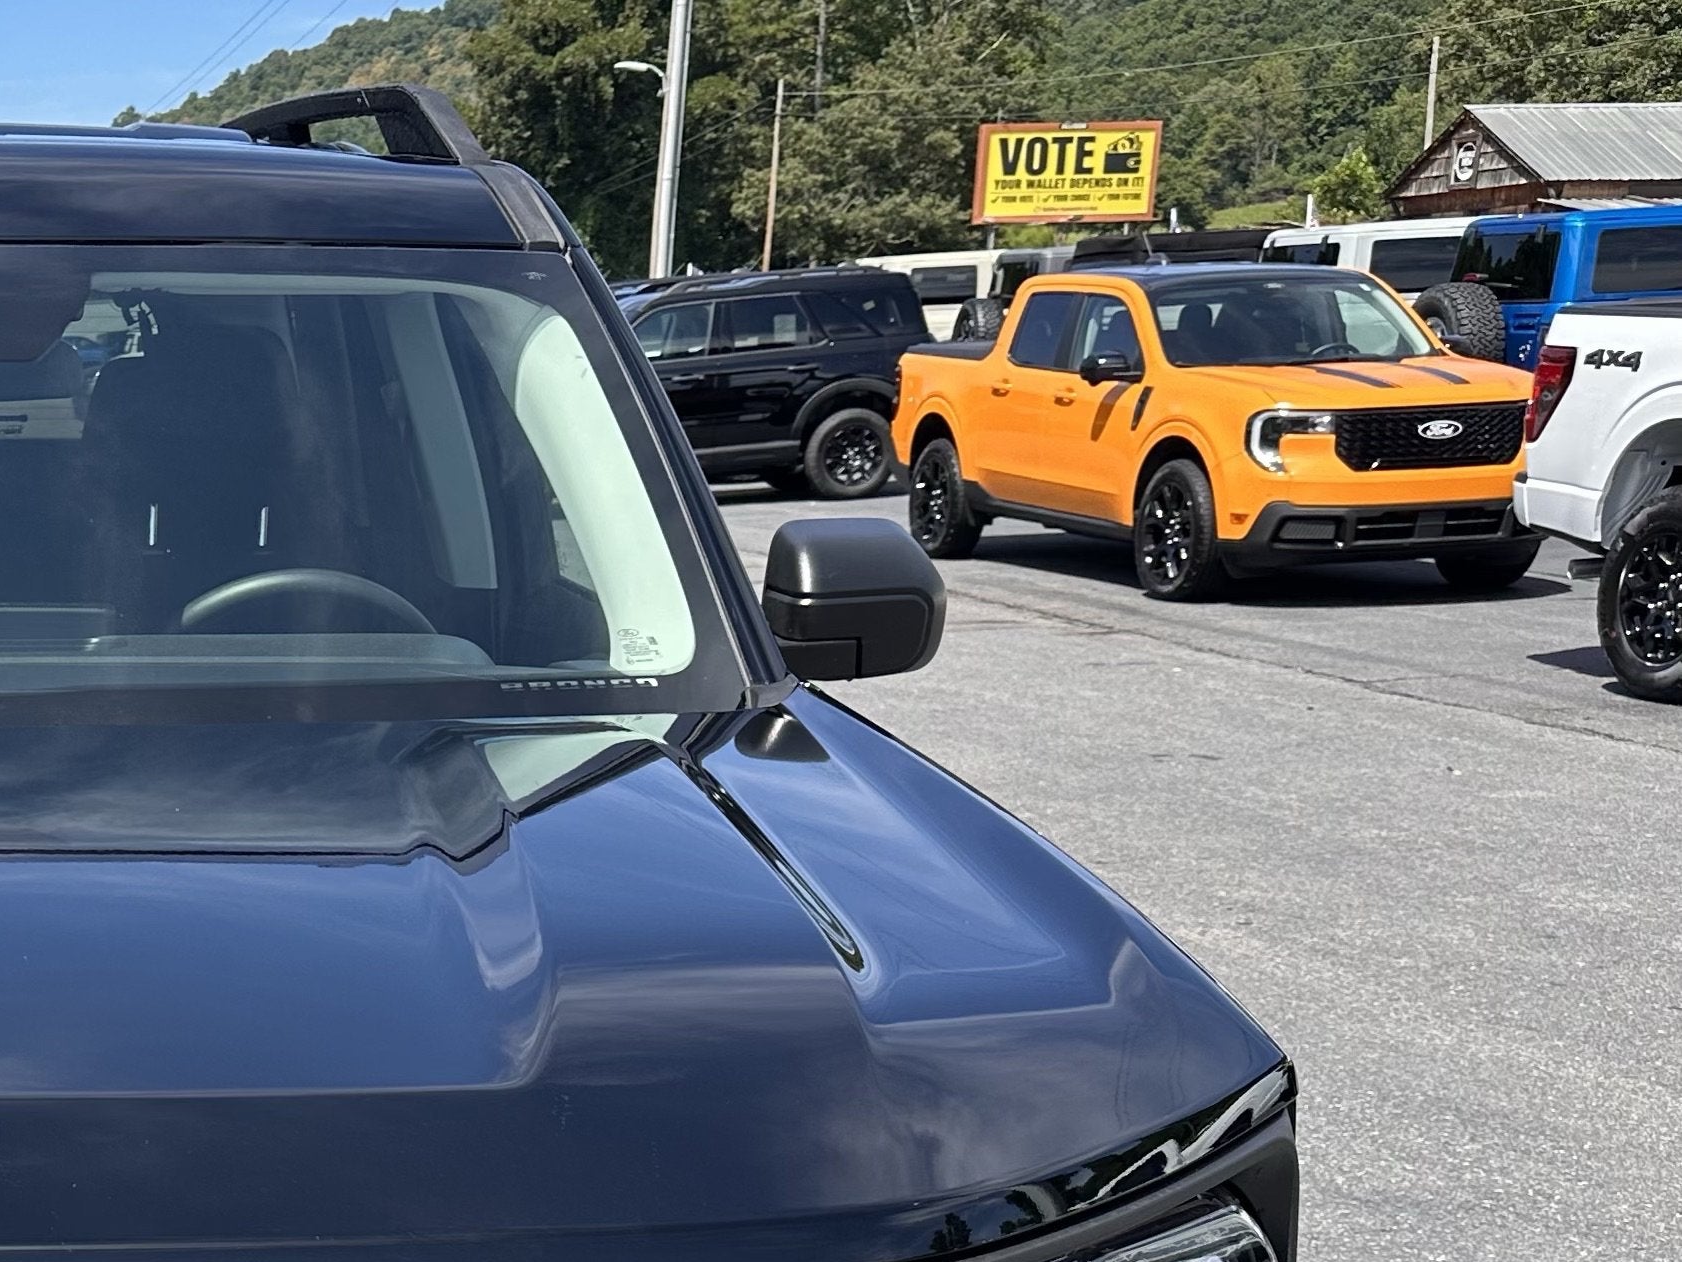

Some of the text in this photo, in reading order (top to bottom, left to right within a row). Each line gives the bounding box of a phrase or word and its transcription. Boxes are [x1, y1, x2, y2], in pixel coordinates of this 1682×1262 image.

[999, 136, 1096, 176] VOTE
[994, 178, 1022, 190] YOUR
[1025, 177, 1066, 189] WALLET
[1069, 176, 1113, 189] DEPENDS
[1116, 176, 1129, 188] ON
